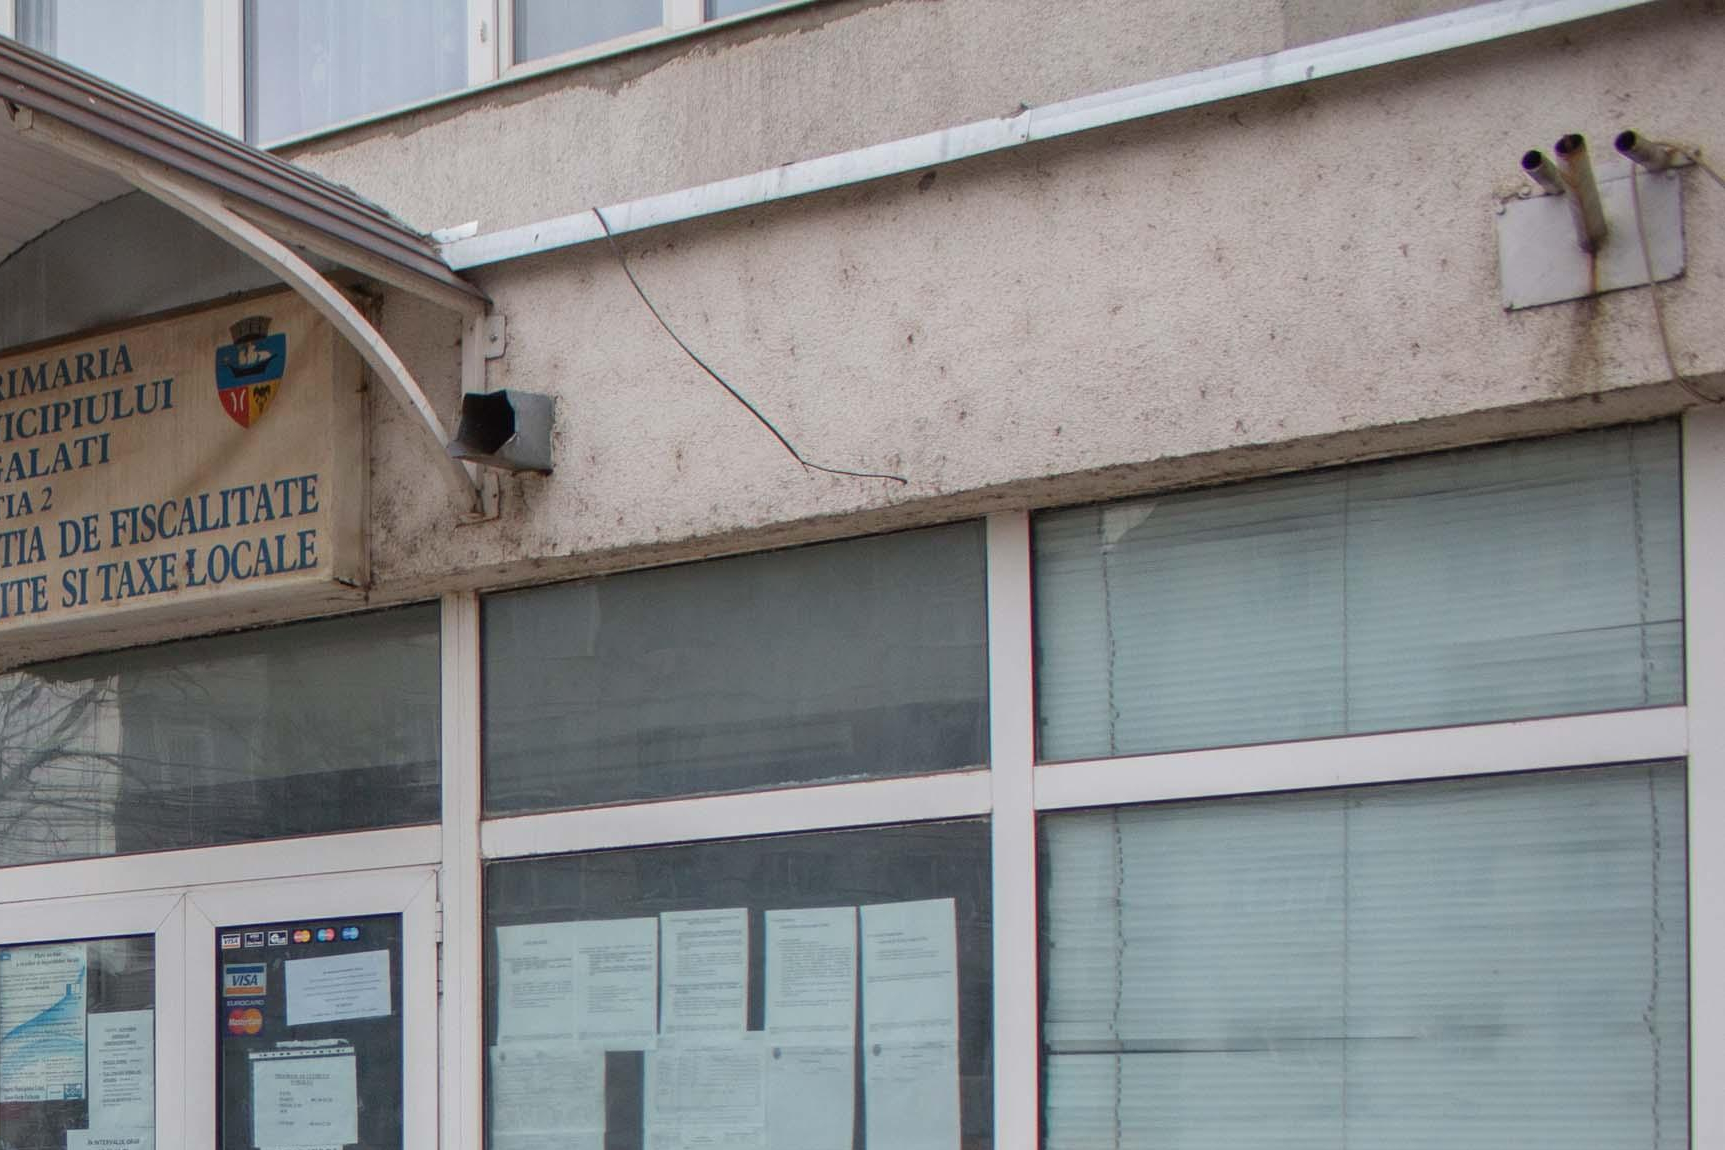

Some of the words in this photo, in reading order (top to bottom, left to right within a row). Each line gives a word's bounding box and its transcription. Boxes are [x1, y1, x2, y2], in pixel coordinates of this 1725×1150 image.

[41, 487, 53, 512] 2
[58, 514, 101, 558] DE
[110, 474, 319, 548] FISCALITATE
[62, 568, 89, 608] SI
[97, 553, 178, 602] TAXE
[185, 529, 318, 587] LOCALE
[232, 974, 258, 987] VISA
